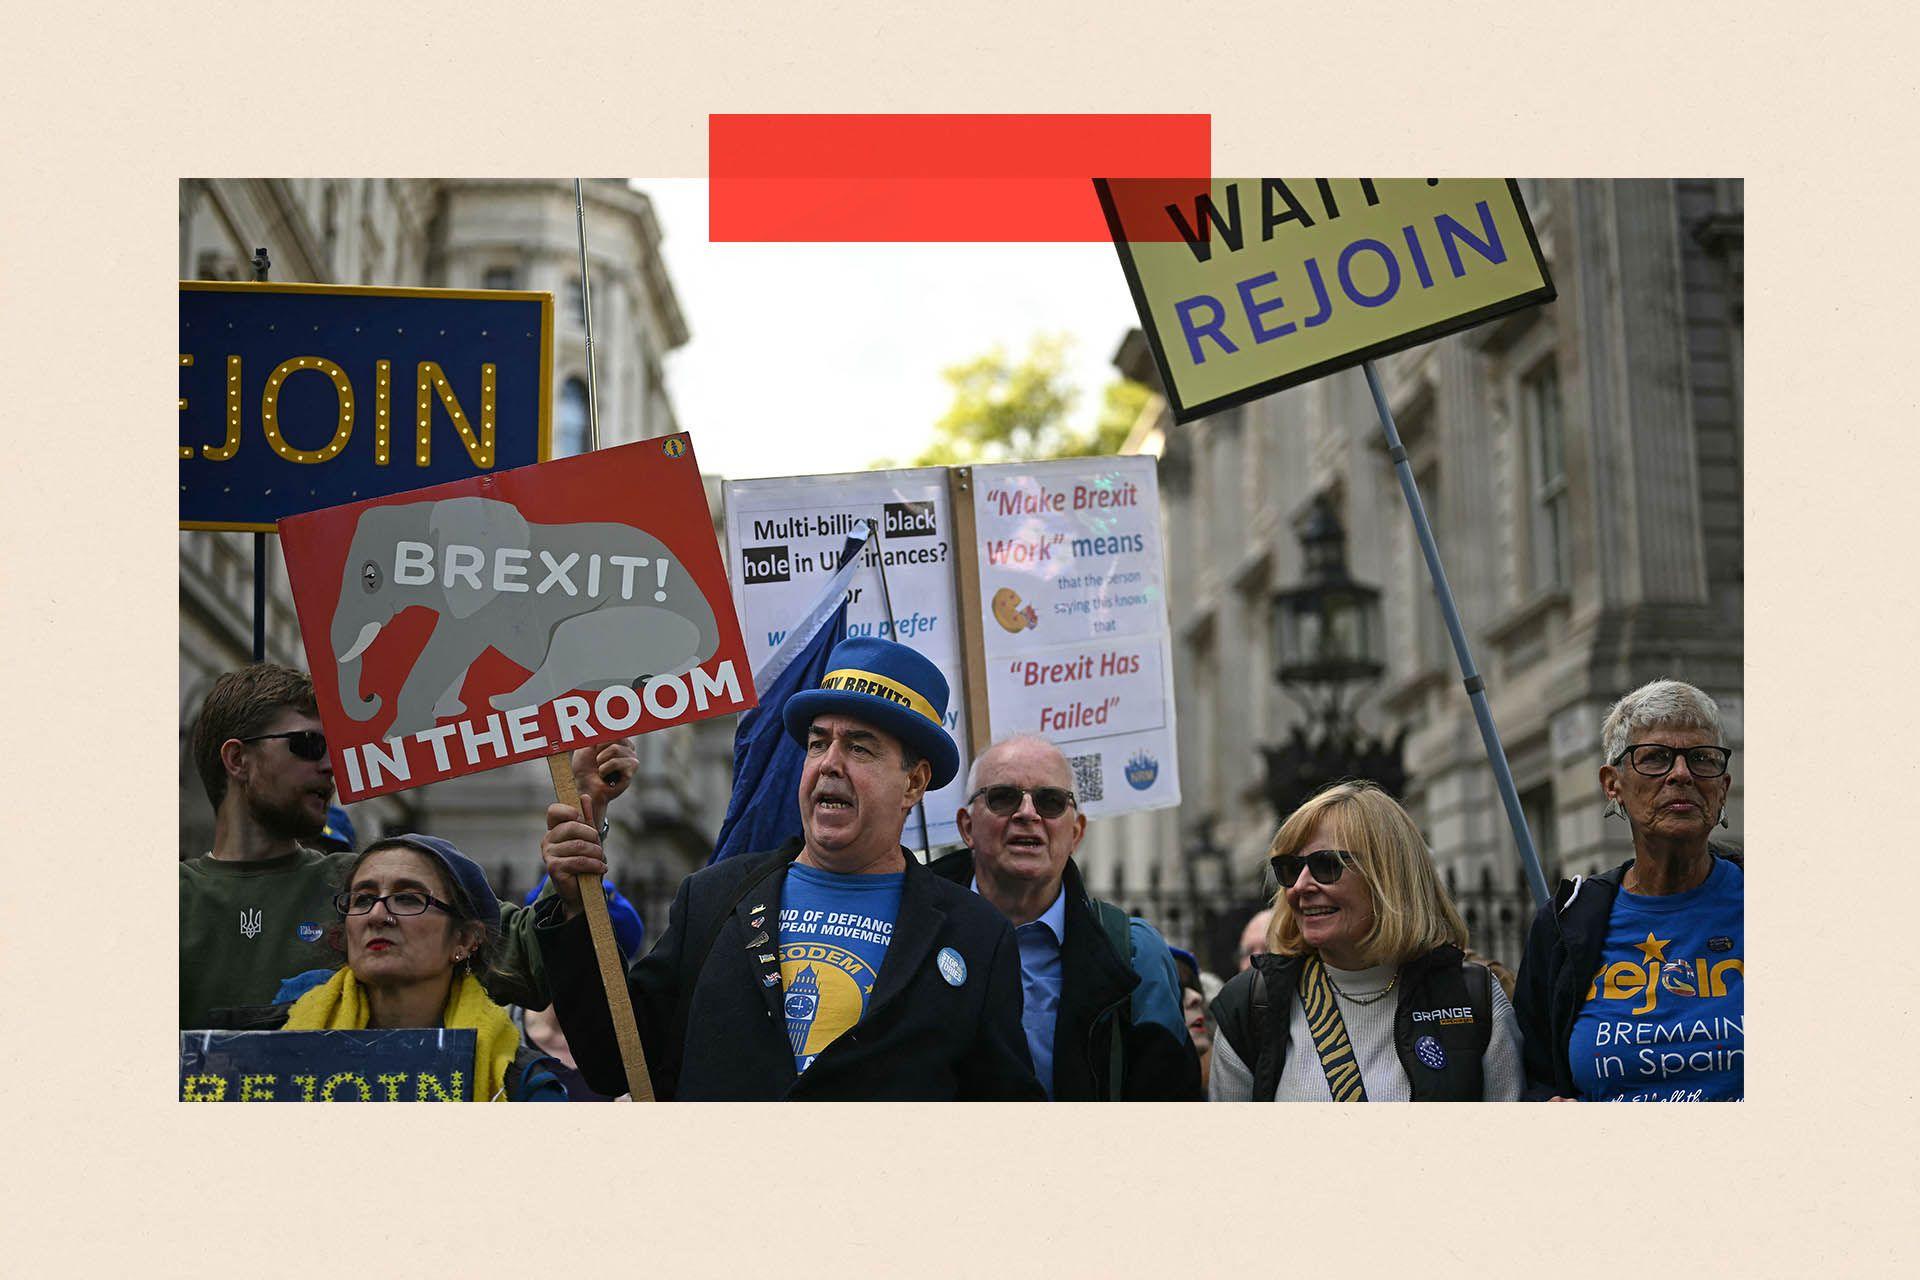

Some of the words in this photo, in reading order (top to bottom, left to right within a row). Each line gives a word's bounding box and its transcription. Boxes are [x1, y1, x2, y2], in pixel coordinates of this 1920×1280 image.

[1175, 200, 1507, 364] REJOIN
[180, 355, 495, 469] JOIN
[1072, 482, 1138, 510] Brexit
[885, 508, 936, 532] black
[743, 555, 789, 577] hole
[795, 553, 814, 573] in
[857, 542, 948, 568] inances?
[1071, 533, 1144, 557] means
[394, 540, 669, 602] BREXIT!
[1058, 574, 1081, 590] that
[1084, 573, 1103, 587] the
[848, 622, 872, 638] ou
[1093, 618, 1116, 632] that
[1010, 655, 1094, 687] “Brexit
[1100, 652, 1140, 677] Has
[342, 736, 411, 793] IN
[416, 704, 548, 772] THE
[553, 660, 744, 743] ROOM
[1040, 697, 1120, 732] Failed”
[779, 921, 816, 934] PEAN
[820, 924, 892, 946] MOVEMEN
[803, 910, 824, 922] OF
[827, 912, 893, 934] DEFIANC
[1412, 1006, 1473, 1022] GRANGE
[1595, 1015, 1744, 1047] BREMAIN
[1594, 1052, 1625, 1078] in
[1638, 1043, 1744, 1079] Spain
